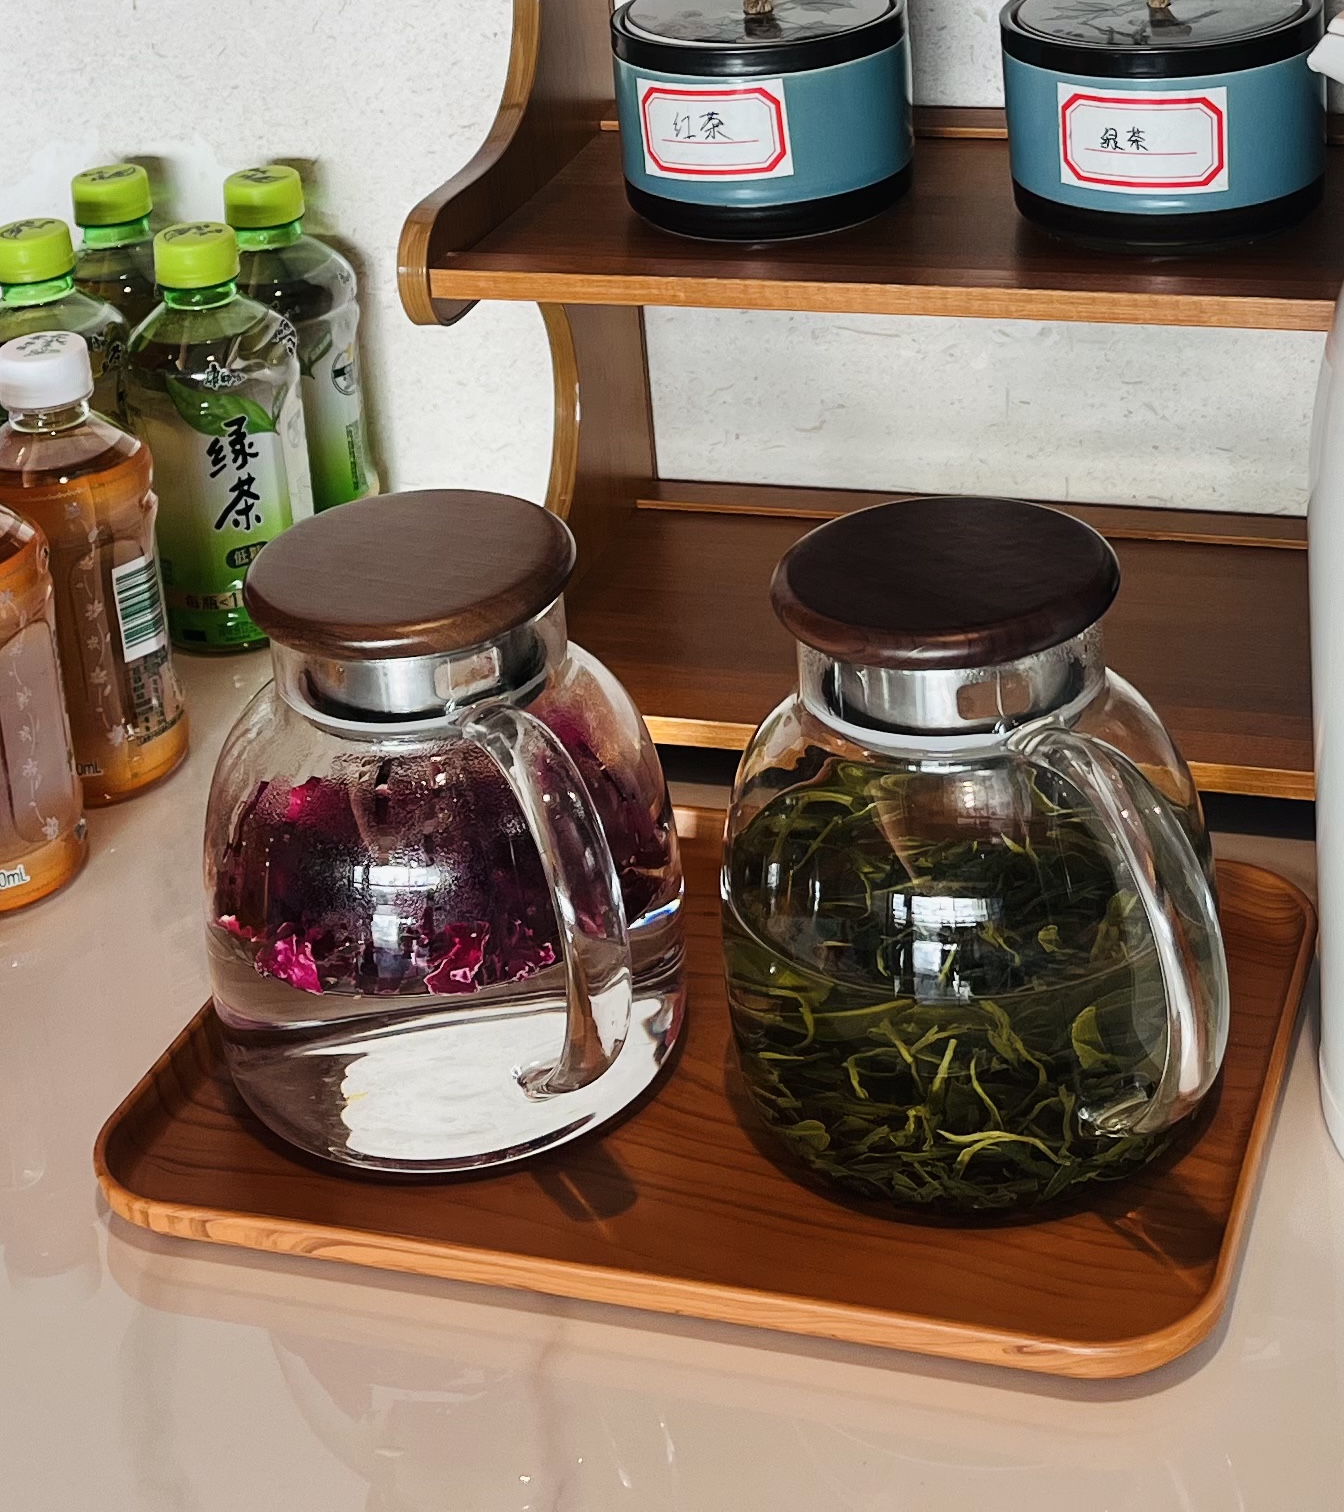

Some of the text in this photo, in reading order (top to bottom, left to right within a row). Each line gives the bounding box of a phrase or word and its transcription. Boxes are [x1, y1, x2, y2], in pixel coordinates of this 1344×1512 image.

[672, 111, 734, 141] 红茶
[1099, 126, 1149, 152] 绿茶
[206, 415, 263, 533] 绿茶
